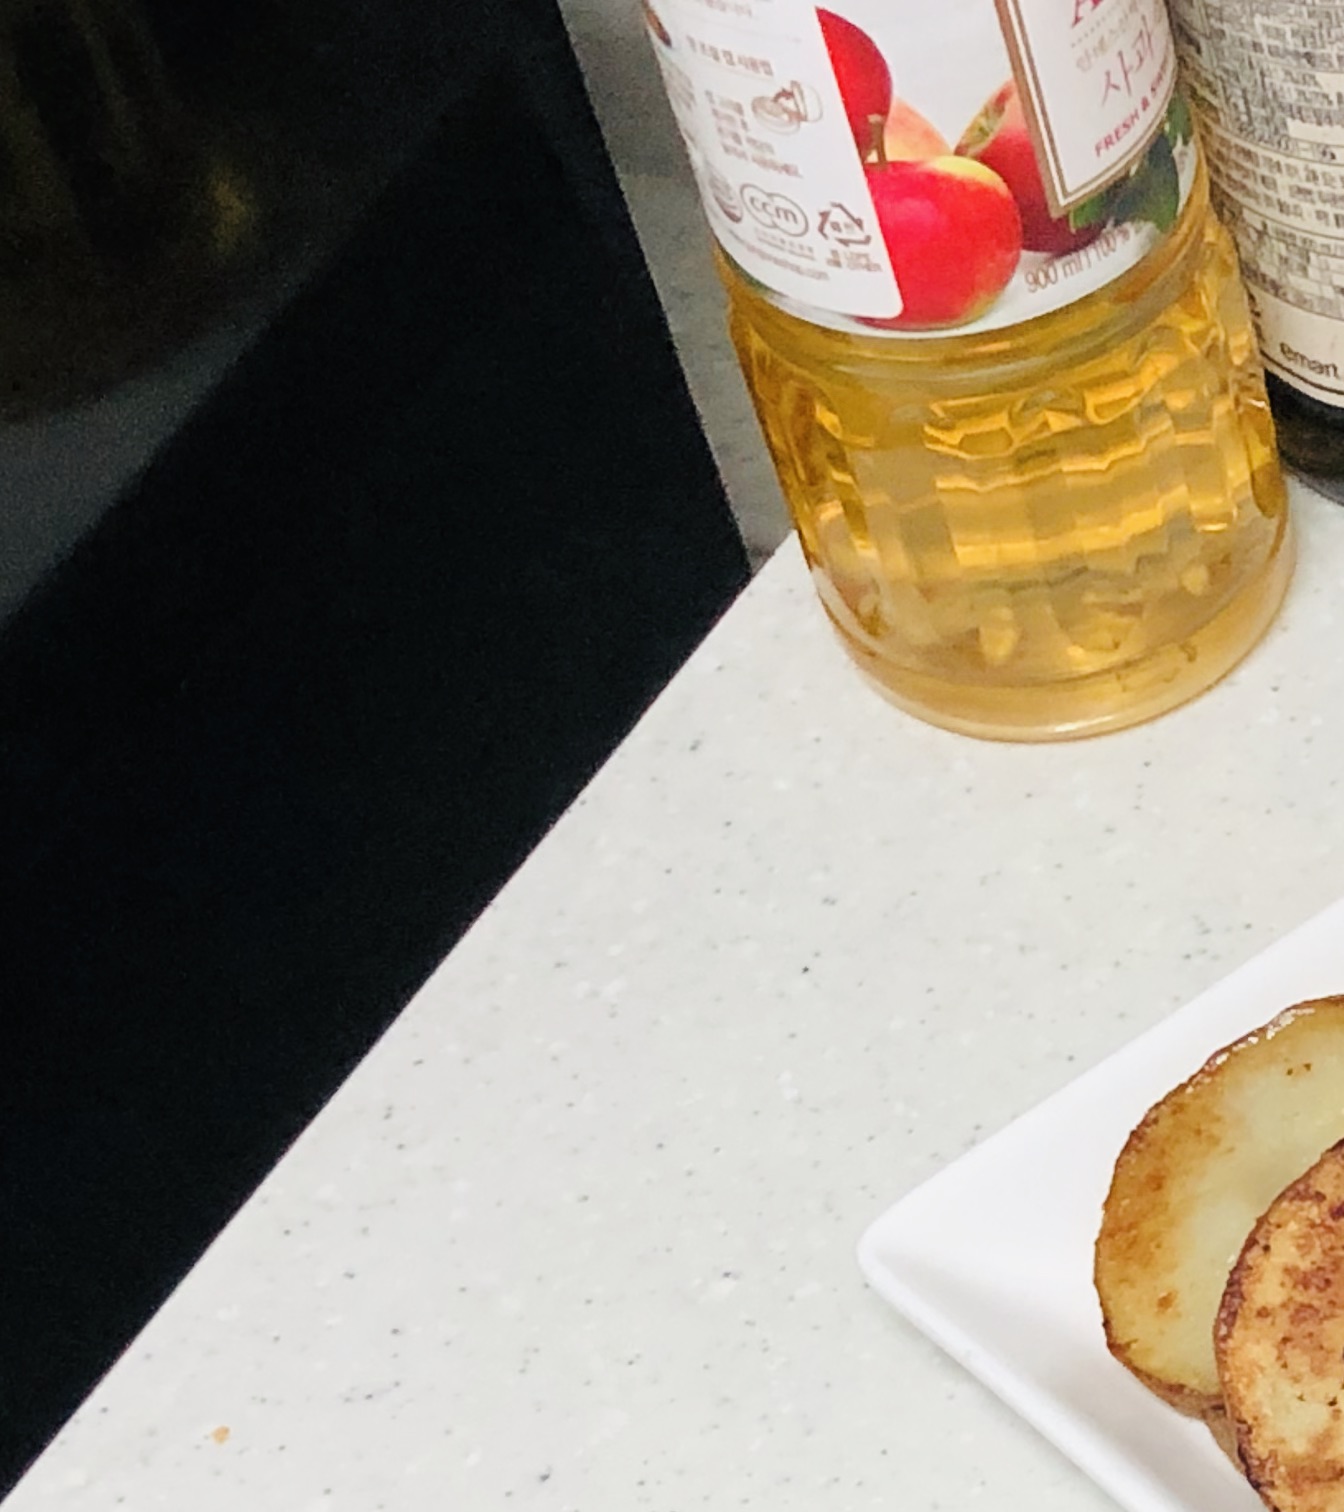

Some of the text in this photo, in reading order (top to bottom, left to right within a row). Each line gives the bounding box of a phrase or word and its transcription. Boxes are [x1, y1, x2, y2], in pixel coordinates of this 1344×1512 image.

[1094, 107, 1141, 158] FRESH
[750, 195, 799, 226] ccm
[1025, 258, 1059, 294] 900
